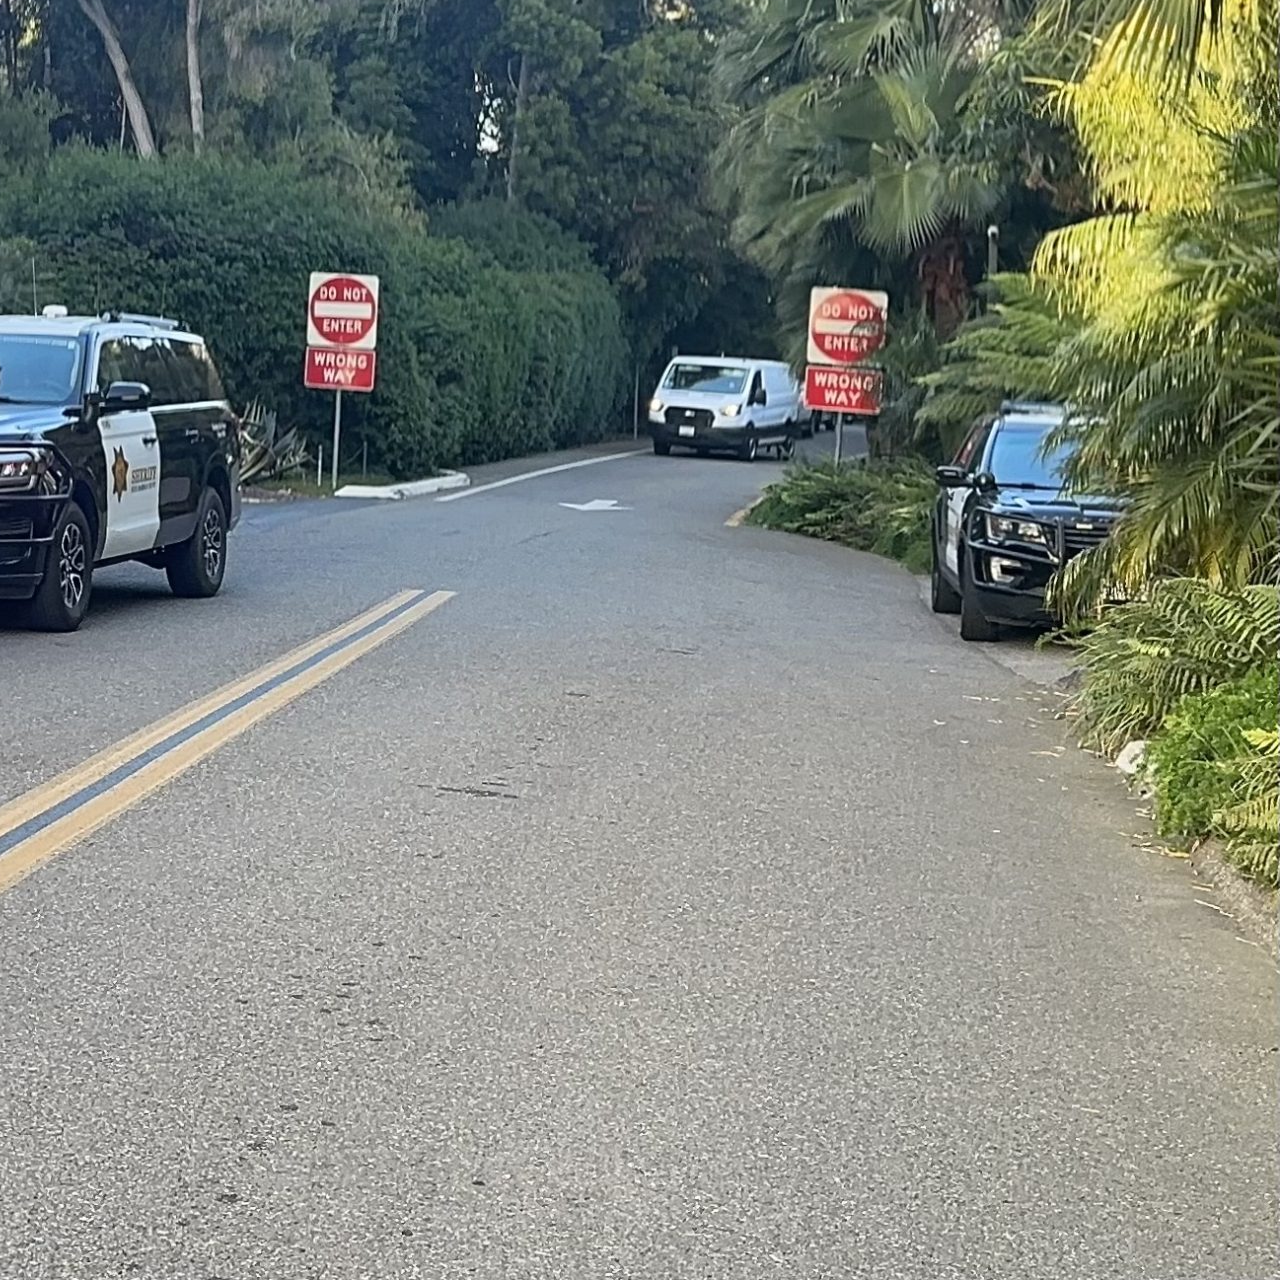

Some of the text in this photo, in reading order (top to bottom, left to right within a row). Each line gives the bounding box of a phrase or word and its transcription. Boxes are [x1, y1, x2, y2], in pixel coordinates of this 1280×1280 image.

[320, 286, 367, 301] DO NOT
[822, 303, 875, 320] DO NOT
[323, 319, 362, 334] ENTER
[825, 335, 868, 353] ENTER
[315, 351, 367, 369] WRONG
[323, 367, 356, 384] WAY
[815, 372, 874, 392] WRONG
[825, 389, 860, 406] WAY
